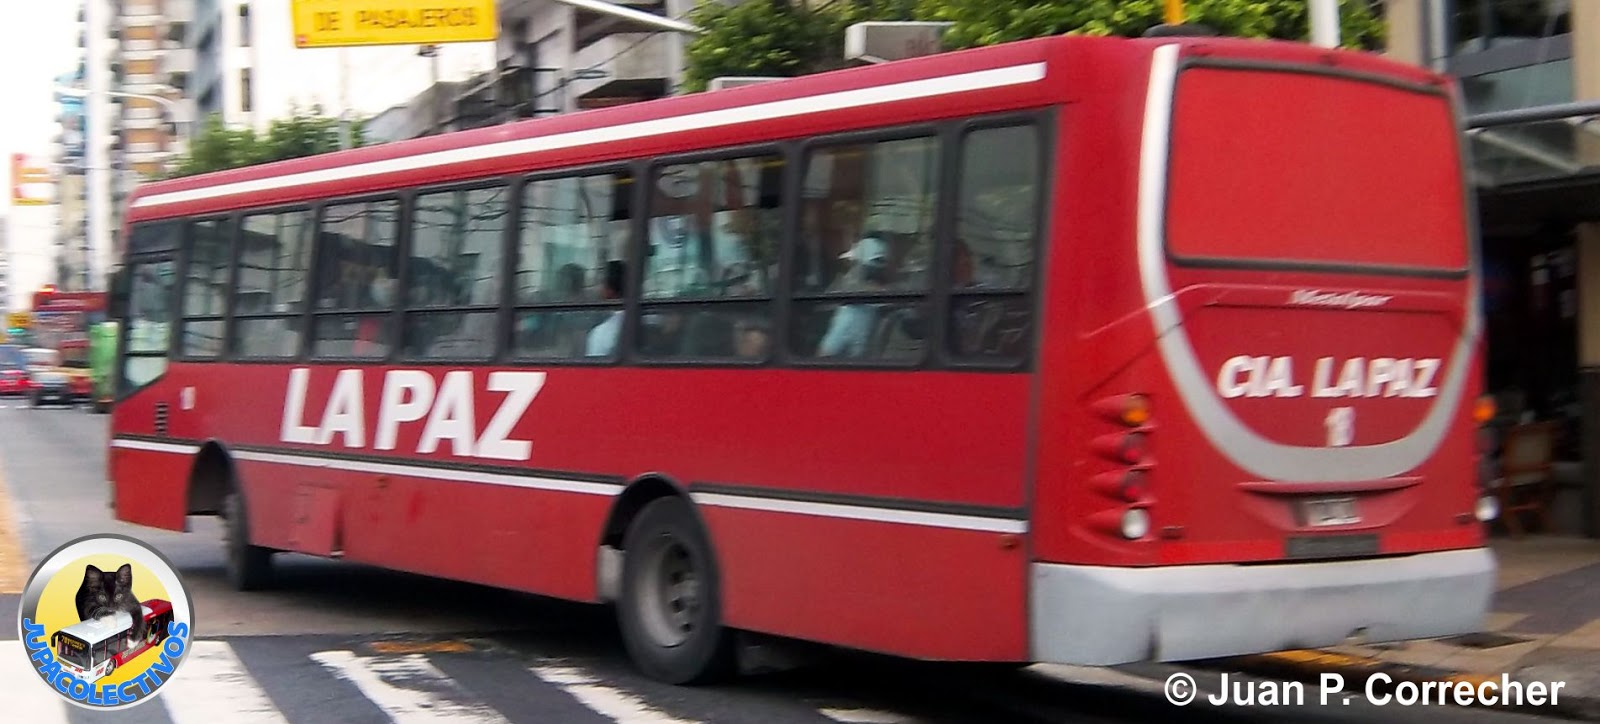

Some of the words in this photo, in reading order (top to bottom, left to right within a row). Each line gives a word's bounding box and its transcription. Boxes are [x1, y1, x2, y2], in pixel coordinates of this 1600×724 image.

[355, 7, 479, 31] PASAJEROS
[1217, 355, 1304, 399] CIA.
[280, 368, 366, 448] LA
[373, 370, 547, 461] PAZ
